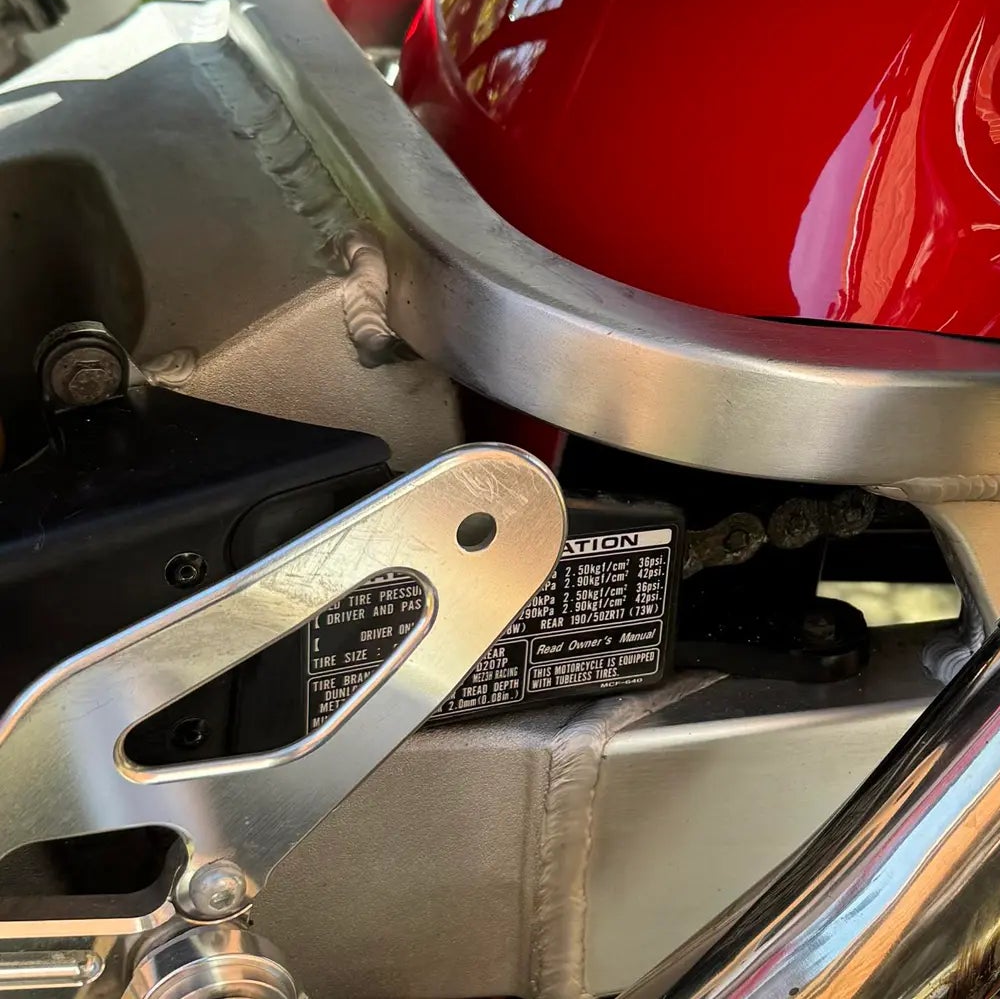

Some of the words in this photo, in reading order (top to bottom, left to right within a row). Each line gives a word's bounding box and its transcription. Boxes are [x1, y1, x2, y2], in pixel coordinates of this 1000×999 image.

[639, 555, 666, 569] 36psi.
[637, 566, 665, 580] 42psi.
[348, 593, 372, 607] TIRE
[380, 585, 422, 602] PRESSU
[636, 580, 664, 593] 36psi.
[635, 591, 663, 604] 42psi.
[327, 609, 365, 625] DRIVER
[373, 603, 394, 617] AND
[540, 617, 564, 630] REAR
[570, 608, 625, 626] 190/50ZR17
[629, 603, 659, 618] (73W)
[361, 627, 393, 641] DRIVER
[536, 642, 564, 655] Read
[568, 636, 612, 651] Owner's
[619, 628, 657, 644] Manual
[313, 655, 336, 669] TIRE
[345, 649, 368, 663] SIZE
[533, 666, 551, 679] THIS
[554, 659, 604, 675] MOTORCYCLE
[607, 657, 616, 667] IS
[618, 651, 655, 666] EQUIPPED
[494, 666, 518, 680] RACING
[532, 678, 552, 689] WITH
[555, 671, 592, 686] TUBELESS
[595, 667, 620, 681] TIRES.
[312, 678, 336, 692] TIRE
[462, 684, 488, 698] TREAD
[493, 679, 520, 692] DEPTH
